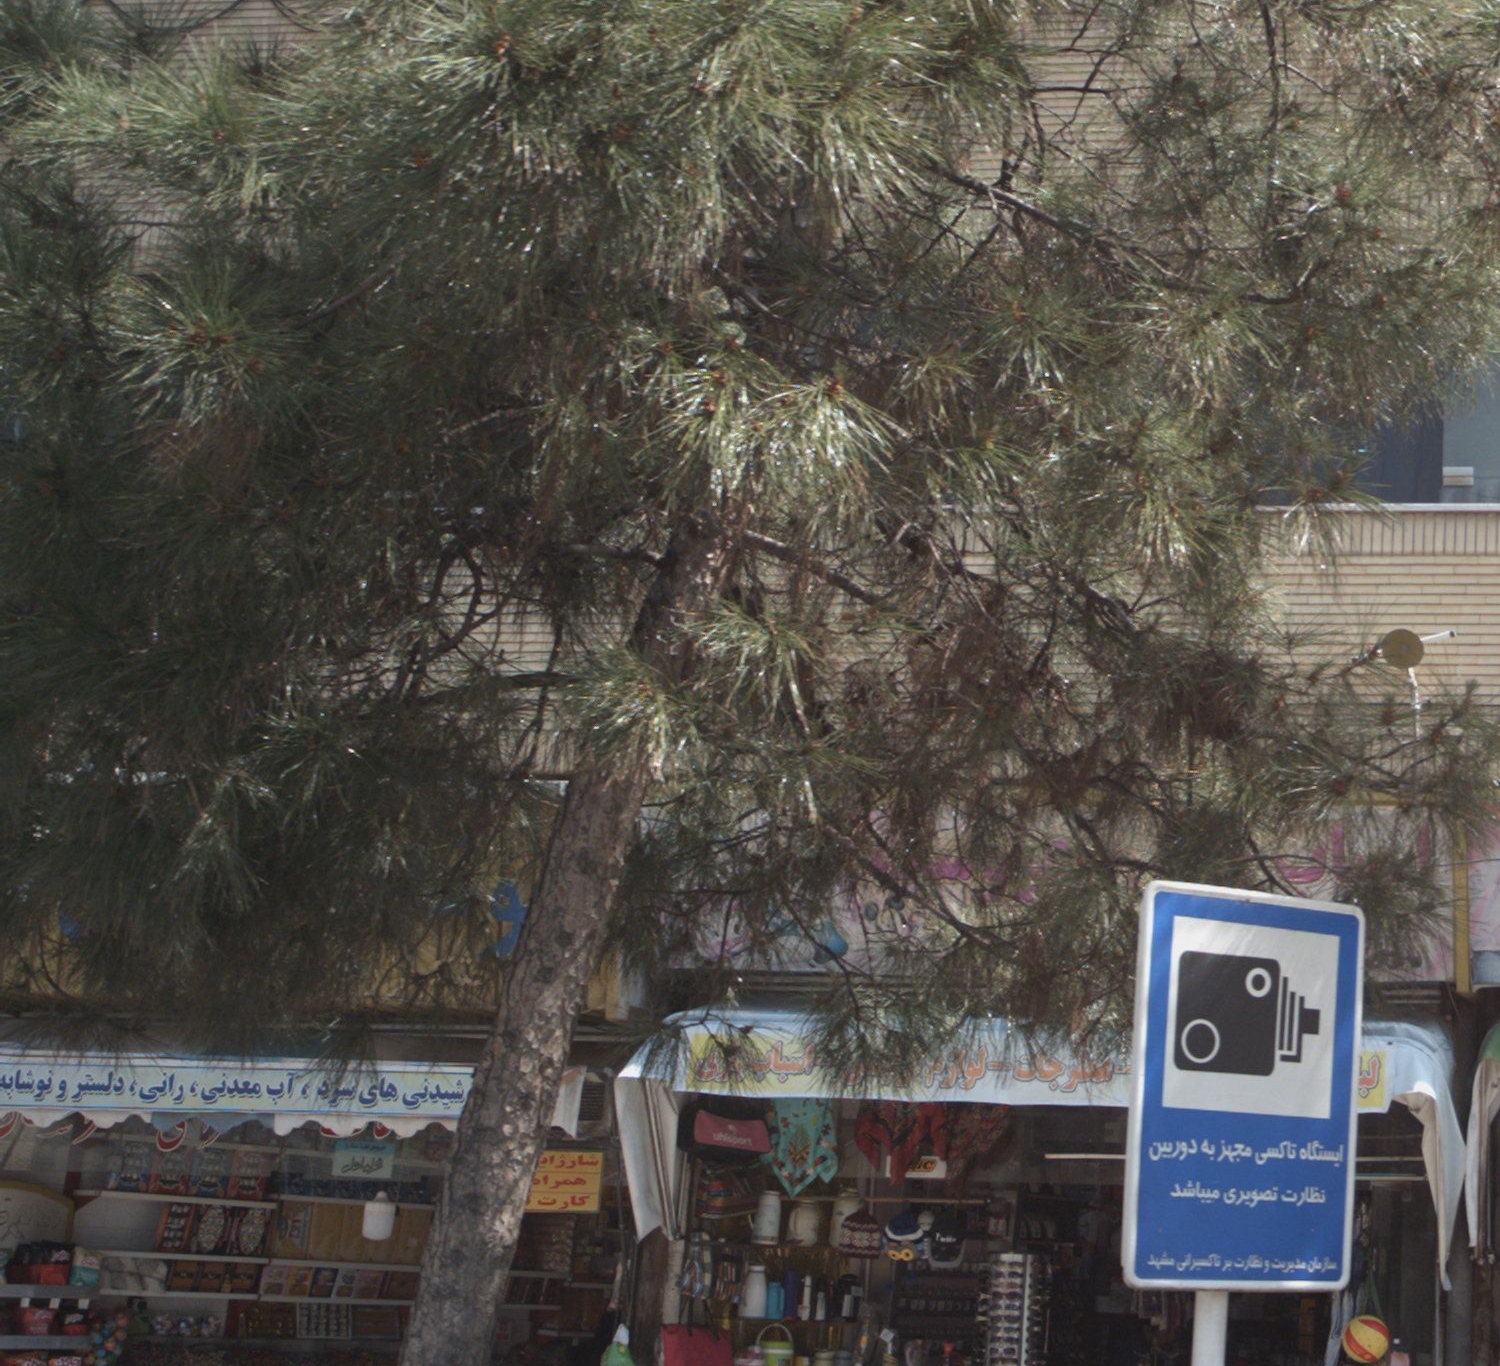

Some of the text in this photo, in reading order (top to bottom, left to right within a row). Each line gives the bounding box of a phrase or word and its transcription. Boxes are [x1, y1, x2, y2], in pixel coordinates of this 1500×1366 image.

[55, 1078, 68, 1101] و
[70, 1071, 125, 1102] دلستر
[265, 1072, 299, 1104] آب
[316, 1077, 357, 1106] سرد
[358, 1074, 399, 1108] های
[401, 1077, 468, 1110] شیدنی
[1148, 1137, 1345, 1168] ایستگاه تاکسی مجهز به دوربین
[537, 1195, 590, 1209] کارت
[1169, 1179, 1327, 1208] نظارت تصویری میباشد
[1146, 1250, 1176, 1270] مشهد
[1176, 1251, 1222, 1272] تاکسیرانی
[1221, 1256, 1233, 1272] بر
[1233, 1253, 1264, 1272] نظارت
[1271, 1256, 1307, 1274] مدیریت
[1307, 1255, 1338, 1274] سازمان
